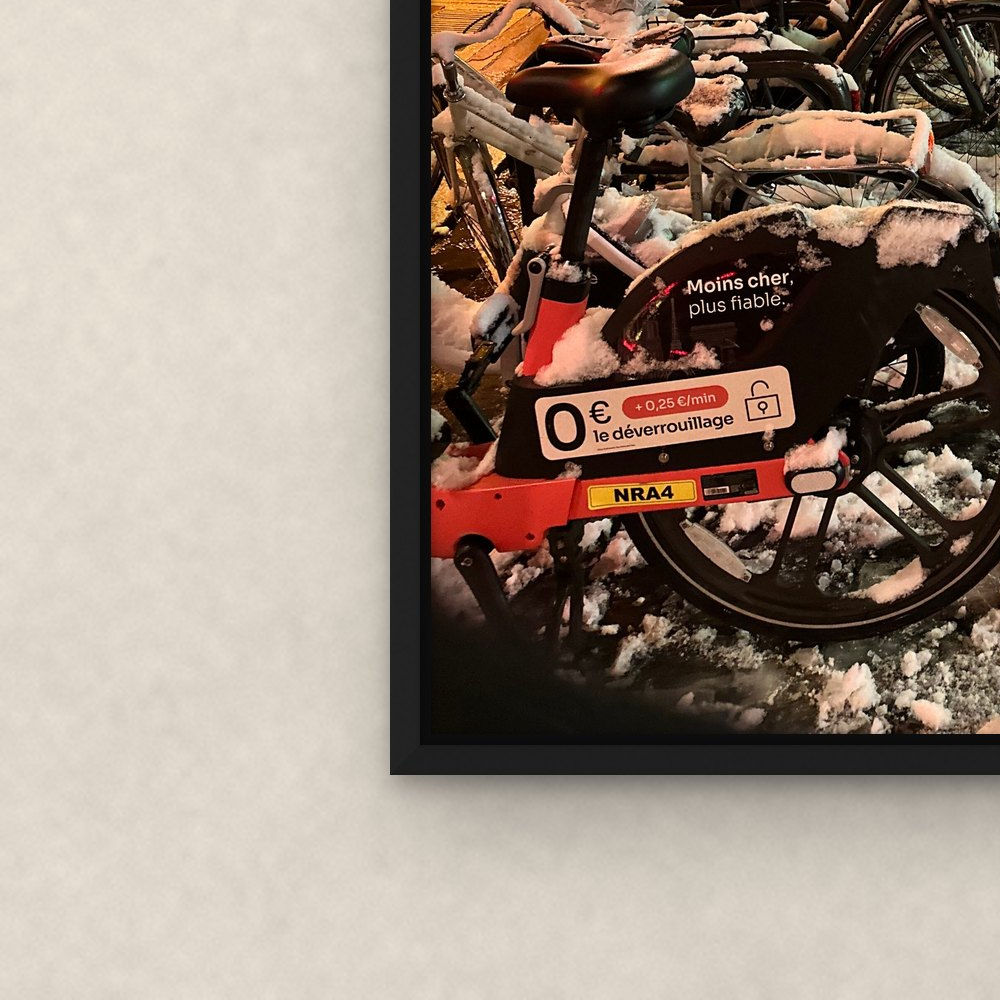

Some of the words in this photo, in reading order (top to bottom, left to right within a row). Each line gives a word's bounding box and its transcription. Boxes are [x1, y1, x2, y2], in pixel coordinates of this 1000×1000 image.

[687, 276, 744, 294] Moins
[747, 271, 794, 289] cher,
[688, 299, 727, 319] plus
[731, 292, 786, 311] fiable.
[589, 400, 612, 424] €
[645, 397, 675, 412] 0,25
[677, 392, 717, 408] €/min
[593, 429, 609, 443] le
[612, 414, 734, 440] déverrouillage
[614, 485, 674, 502] NRA4
